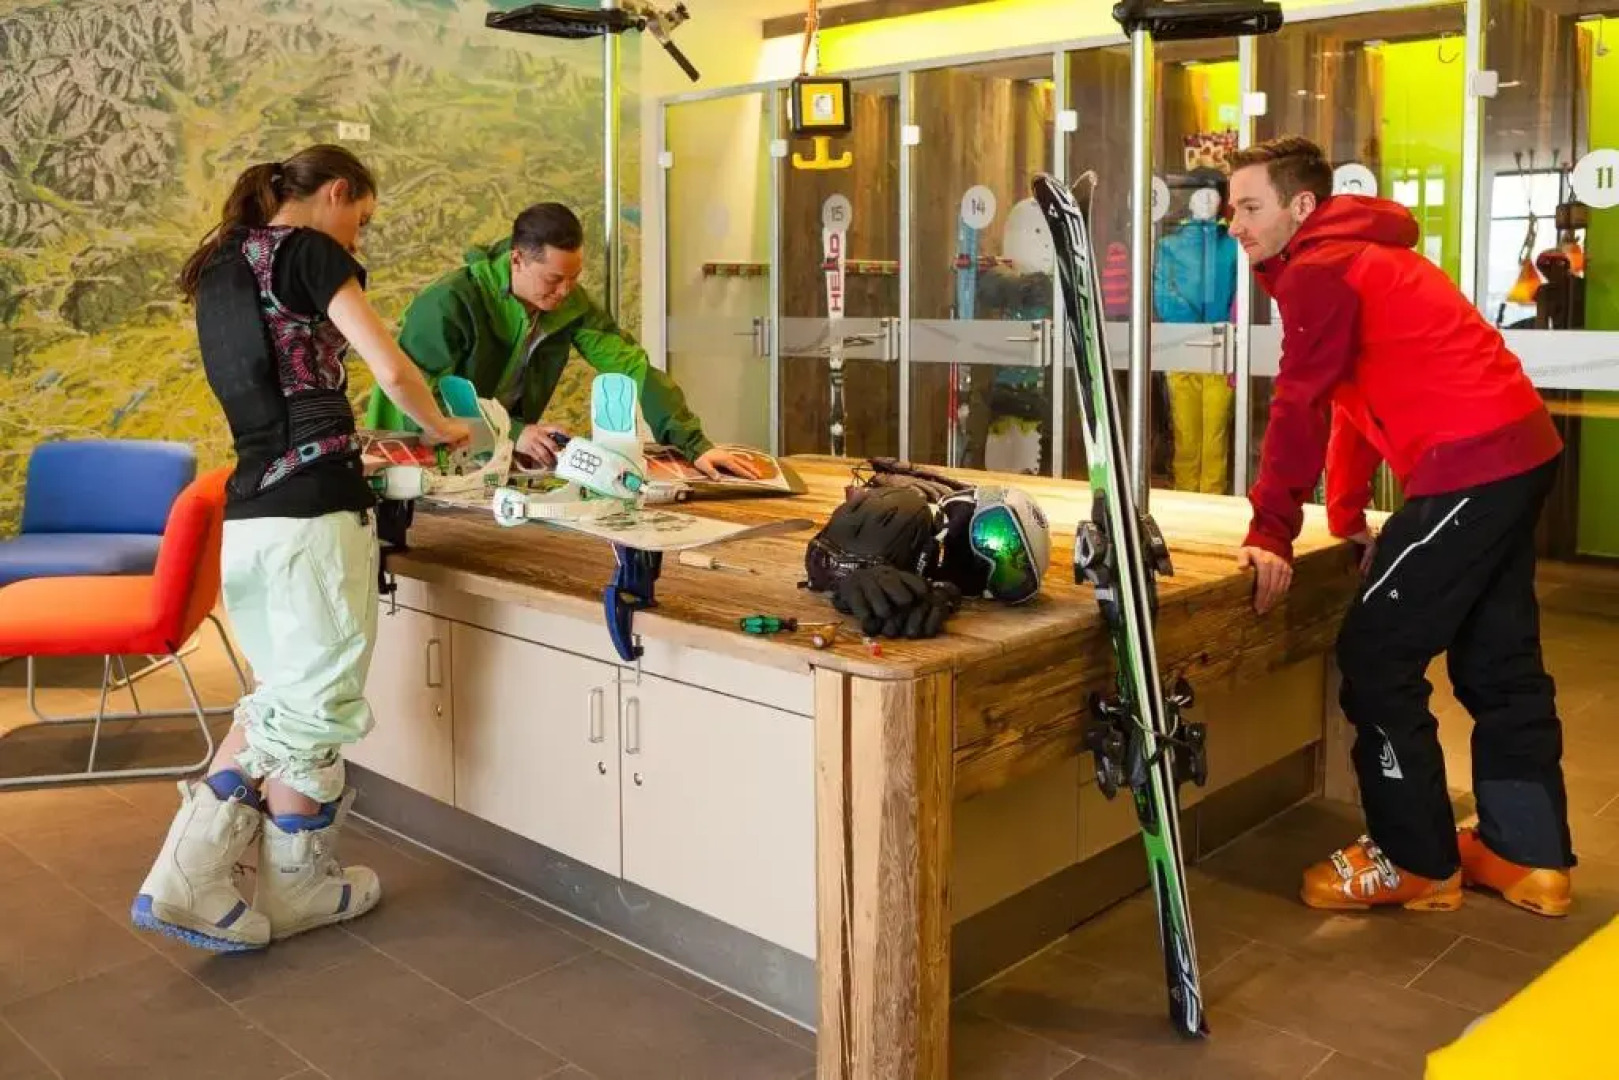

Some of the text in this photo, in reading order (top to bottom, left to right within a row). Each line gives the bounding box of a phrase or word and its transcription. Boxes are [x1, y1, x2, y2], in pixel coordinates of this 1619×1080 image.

[1595, 166, 1614, 189] 11
[831, 205, 844, 221] 15
[971, 197, 986, 215] 14
